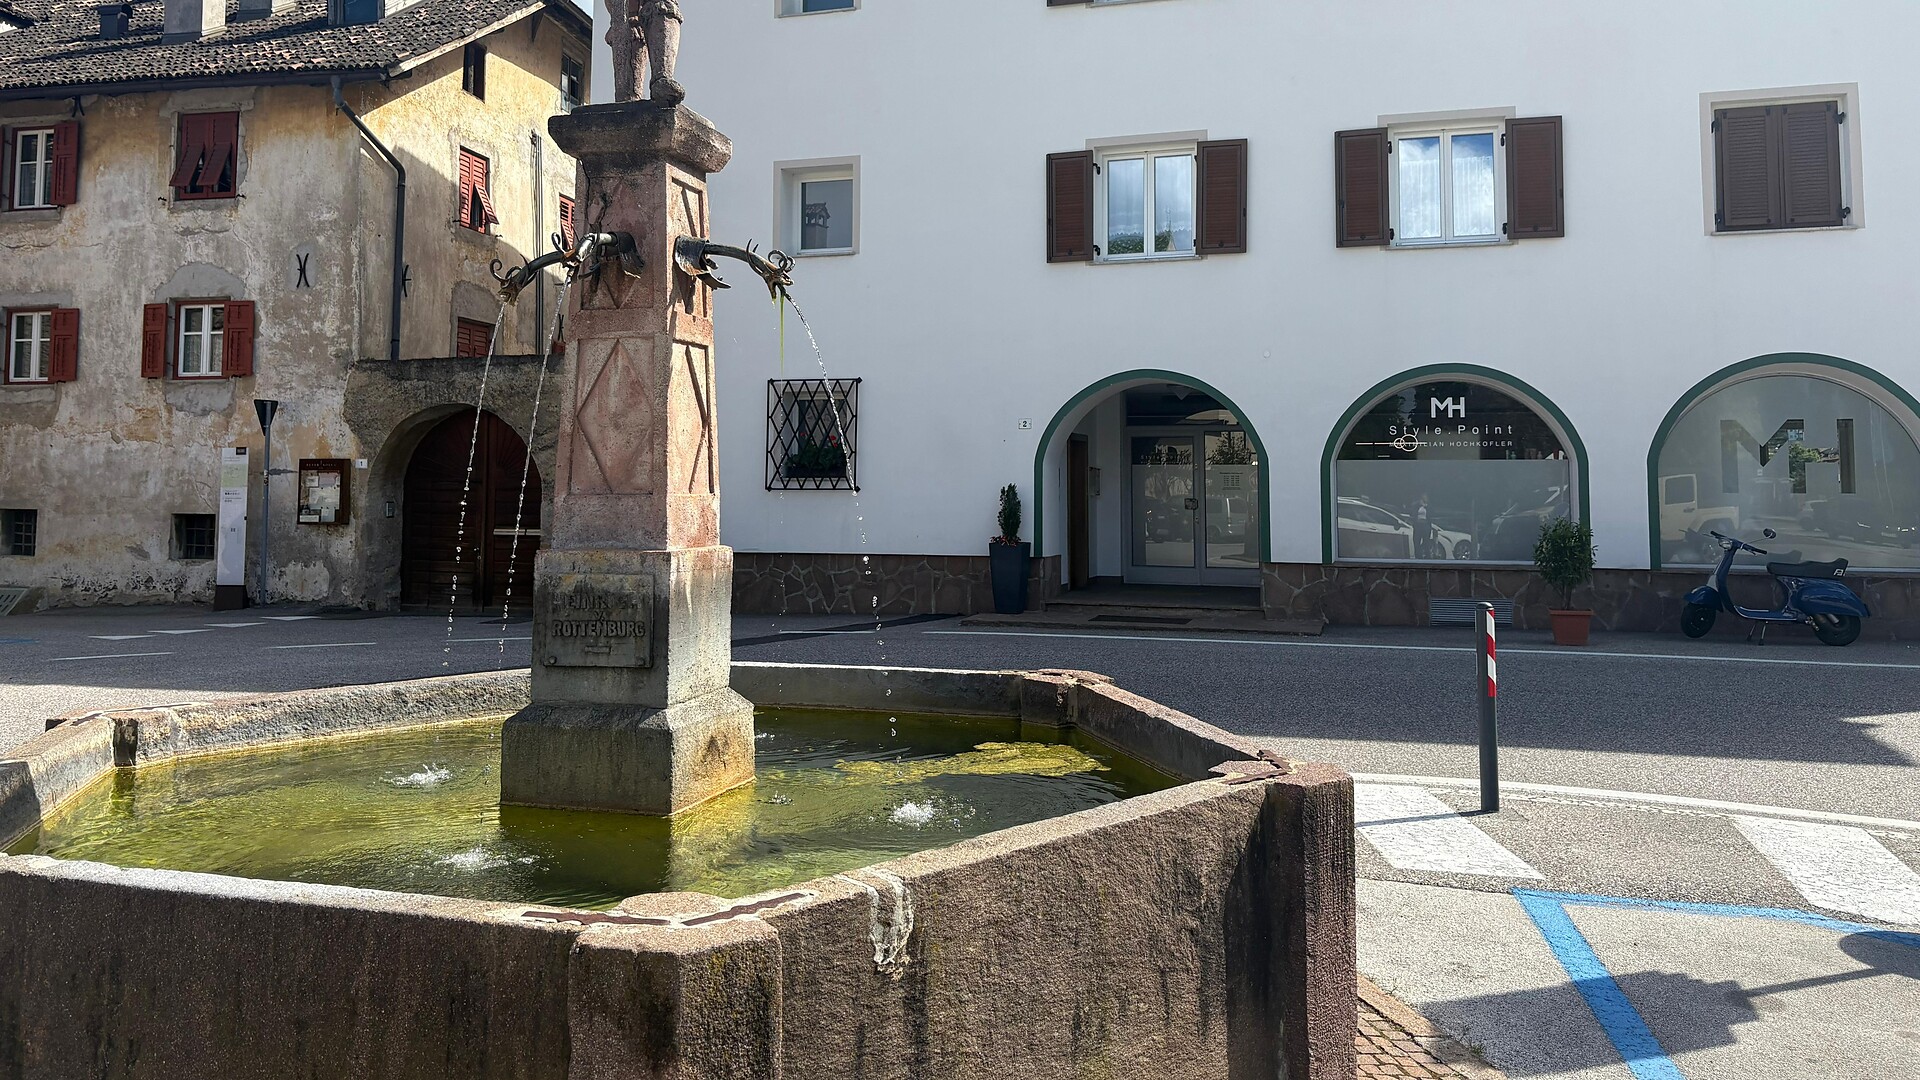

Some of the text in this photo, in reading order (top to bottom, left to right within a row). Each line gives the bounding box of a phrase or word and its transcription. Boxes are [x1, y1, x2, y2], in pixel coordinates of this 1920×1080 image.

[1430, 396, 1466, 419] MH
[1720, 418, 1856, 494] MH
[552, 620, 645, 637] ROTTENBURG
